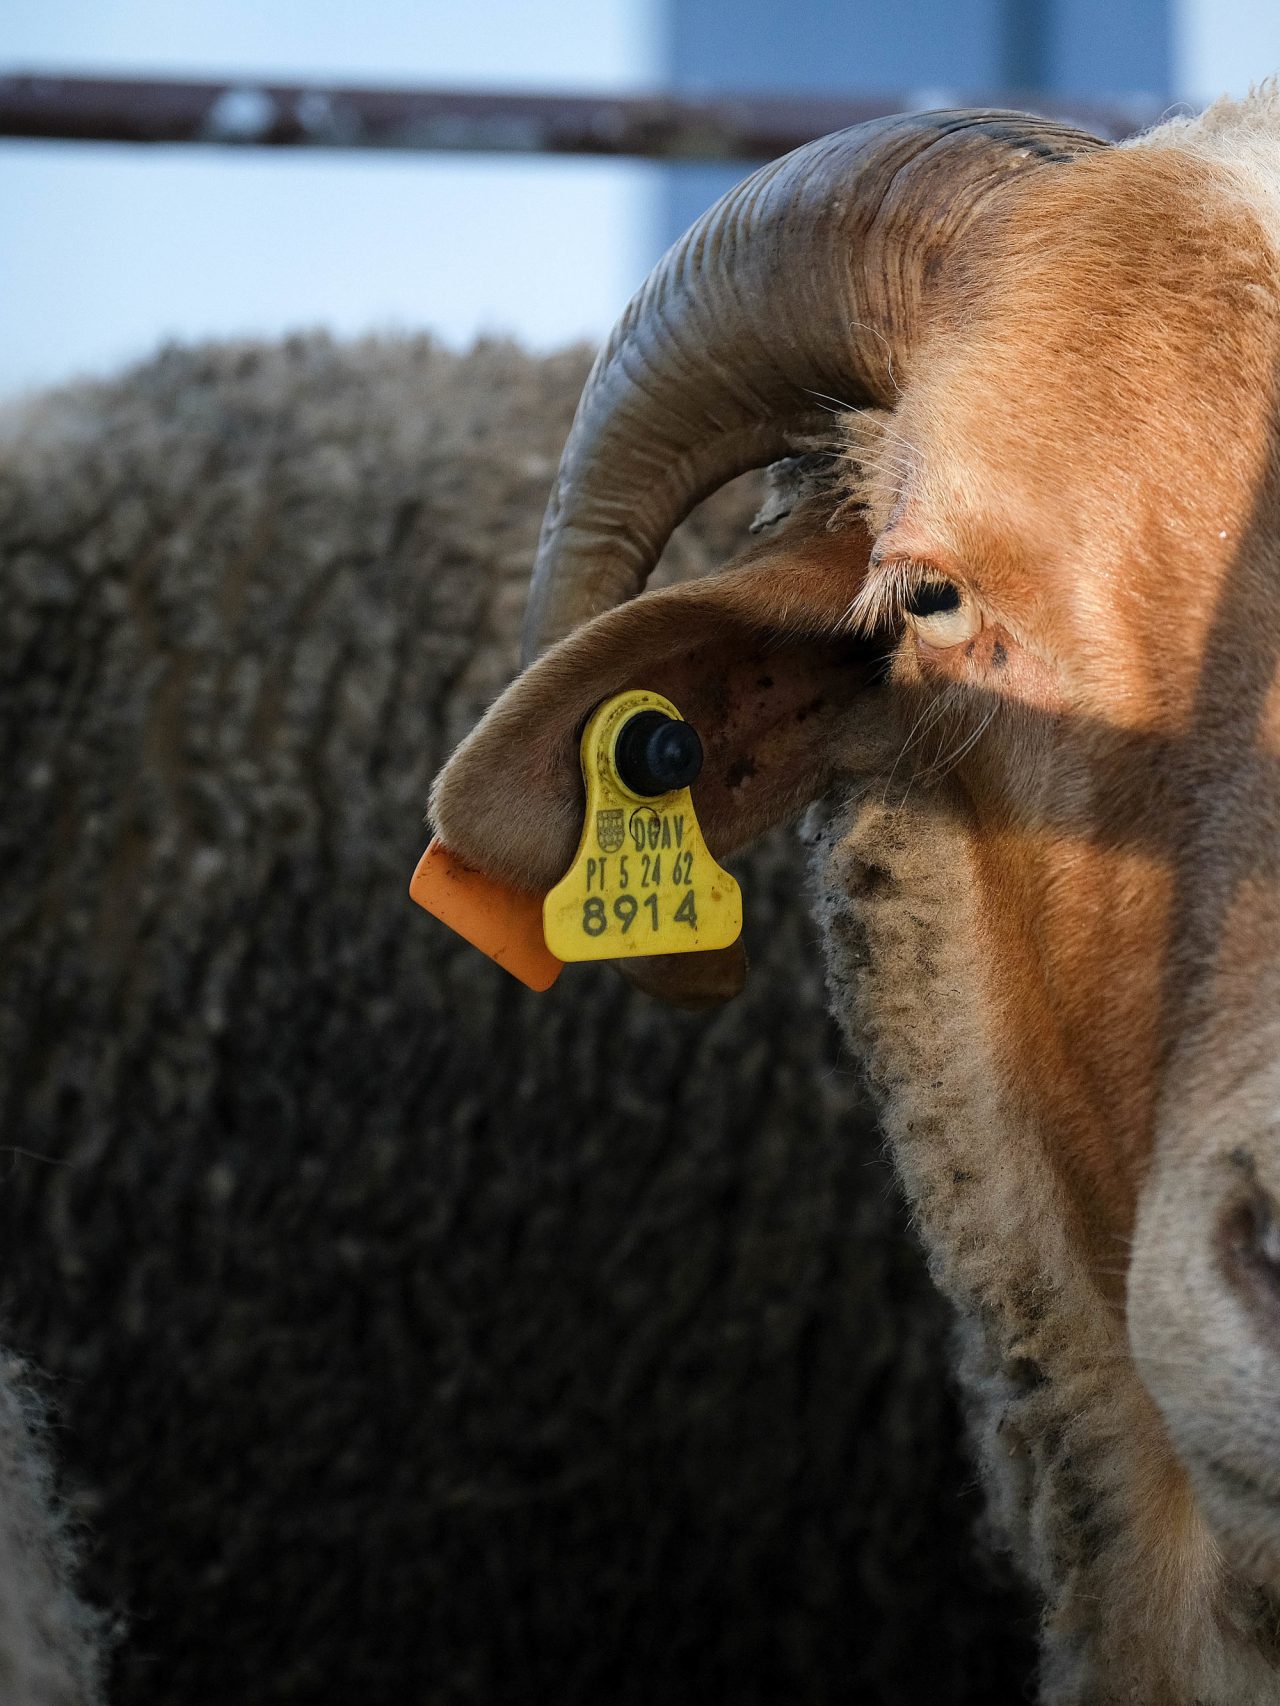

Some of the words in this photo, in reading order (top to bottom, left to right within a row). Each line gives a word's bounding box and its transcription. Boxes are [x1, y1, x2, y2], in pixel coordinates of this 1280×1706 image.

[587, 857, 607, 892] PT
[619, 855, 629, 889] 5
[641, 853, 661, 888] 24
[672, 852, 693, 886] 62
[582, 889, 698, 937] 8914
